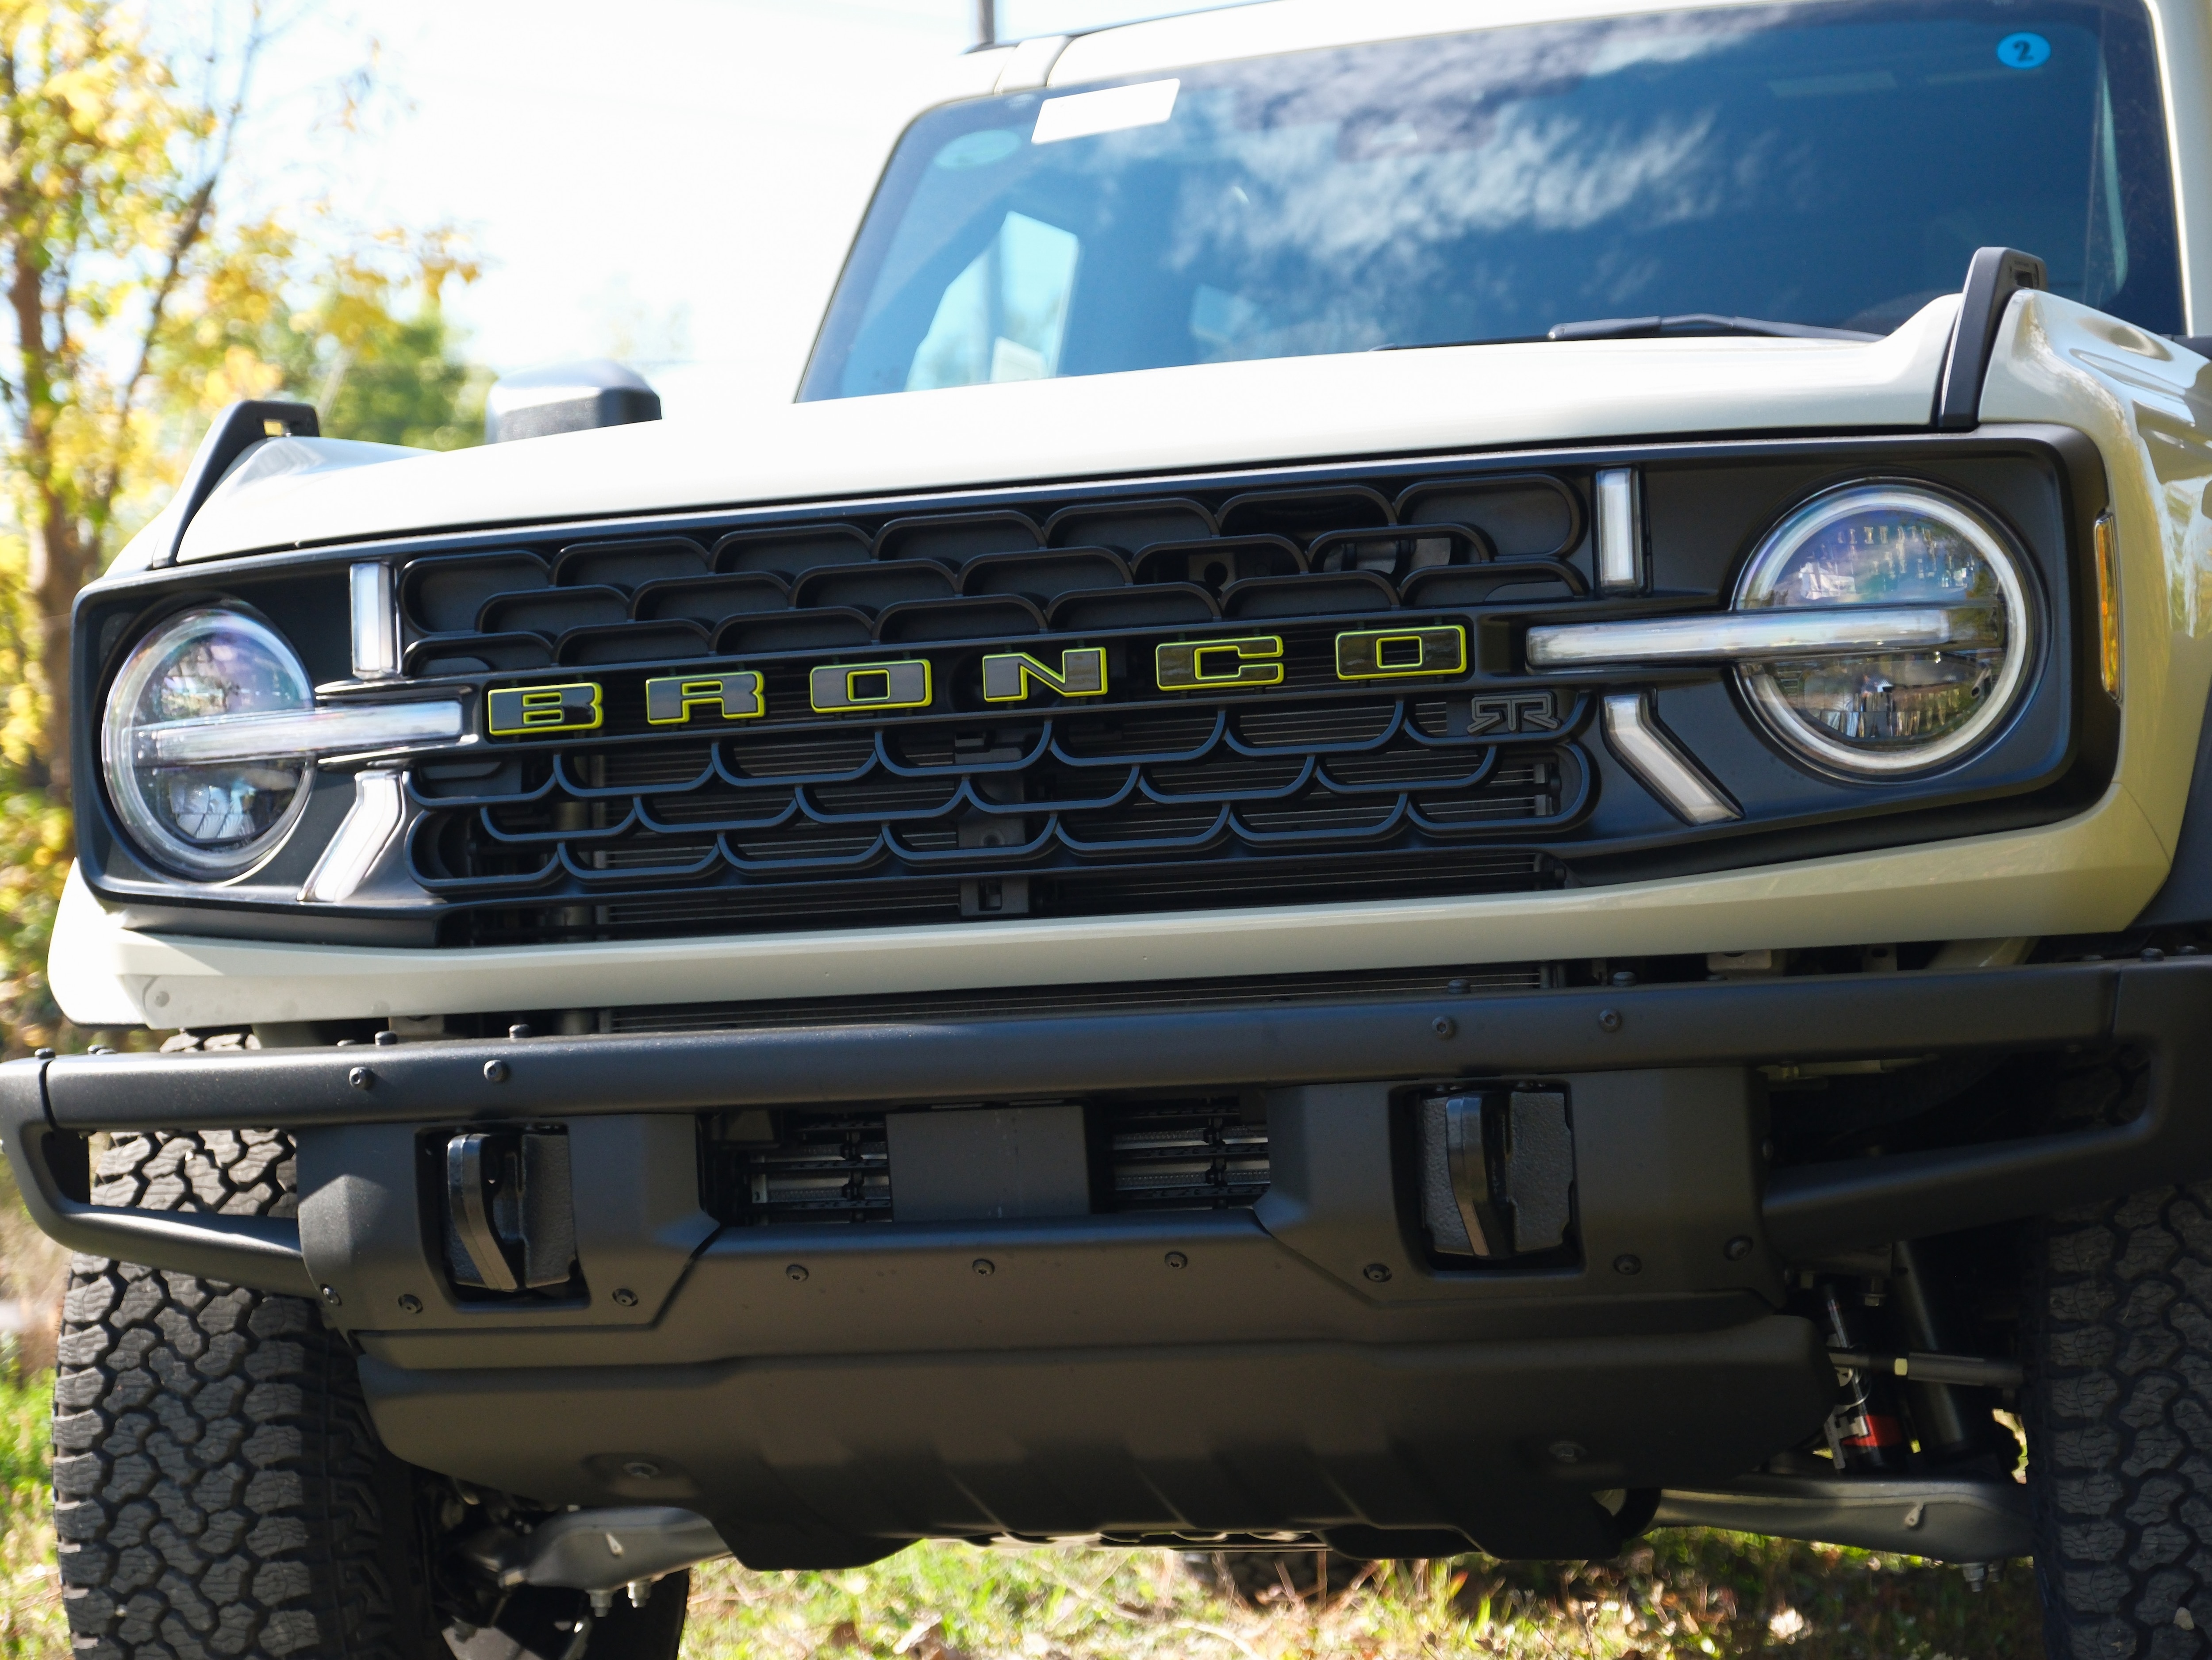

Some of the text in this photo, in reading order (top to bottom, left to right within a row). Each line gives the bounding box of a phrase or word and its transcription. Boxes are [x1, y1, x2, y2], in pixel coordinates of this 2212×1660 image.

[2012, 40, 2034, 62] 2
[488, 624, 1467, 736] BRONCO
[1467, 692, 1559, 735] RTR
